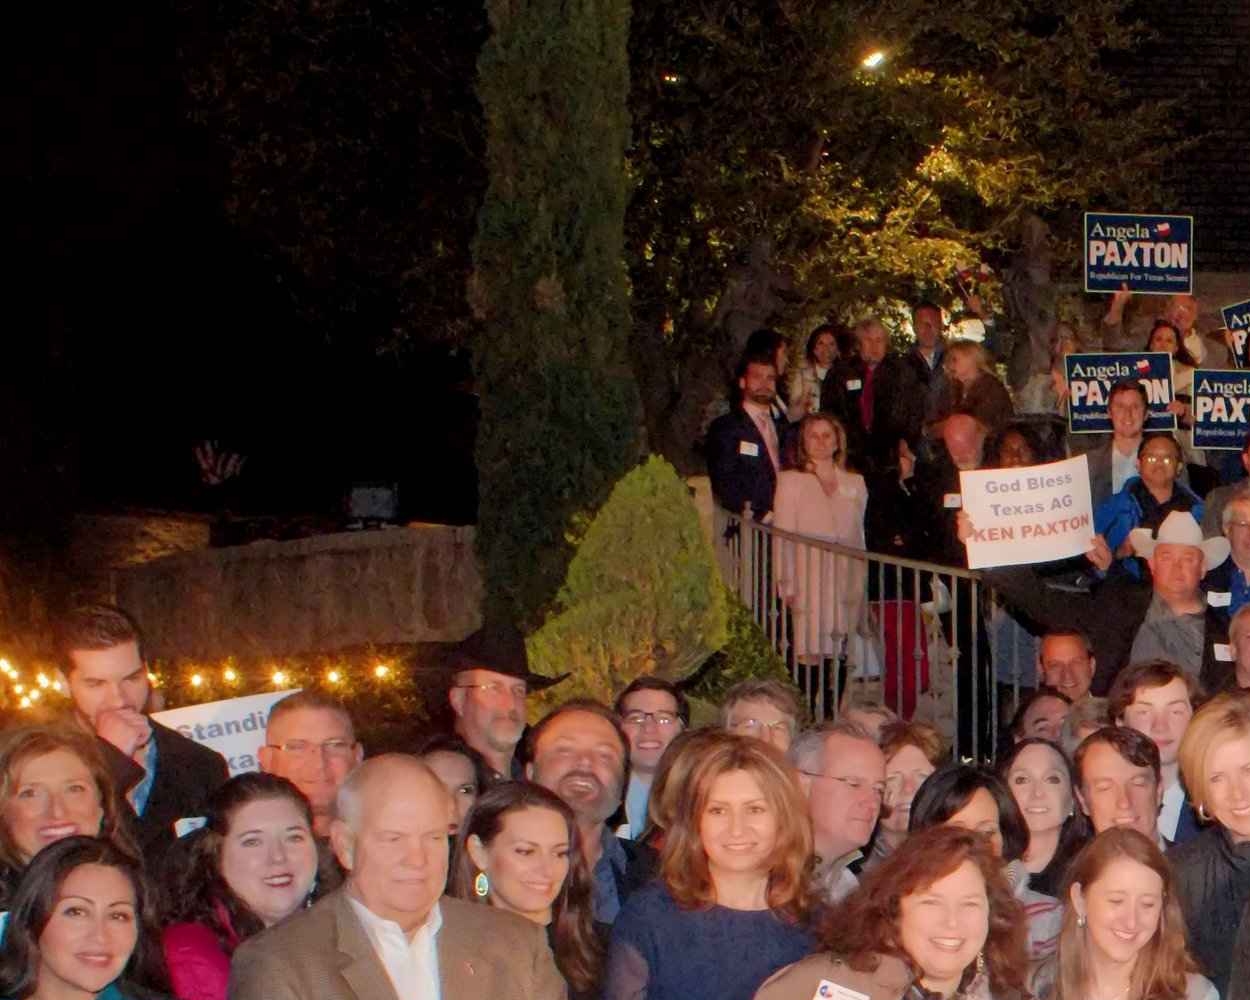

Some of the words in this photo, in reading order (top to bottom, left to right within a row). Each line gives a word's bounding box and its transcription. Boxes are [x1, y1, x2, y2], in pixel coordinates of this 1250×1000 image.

[1090, 222, 1150, 241] Angela
[1090, 240, 1188, 268] PAXTON
[1071, 362, 1130, 380] Angela
[985, 479, 1020, 494] God
[1026, 473, 1072, 490] Bless
[990, 502, 1045, 517] Texas
[1051, 494, 1073, 511] AG
[973, 527, 1014, 543] KEN
[1021, 512, 1090, 538] PAXTON
